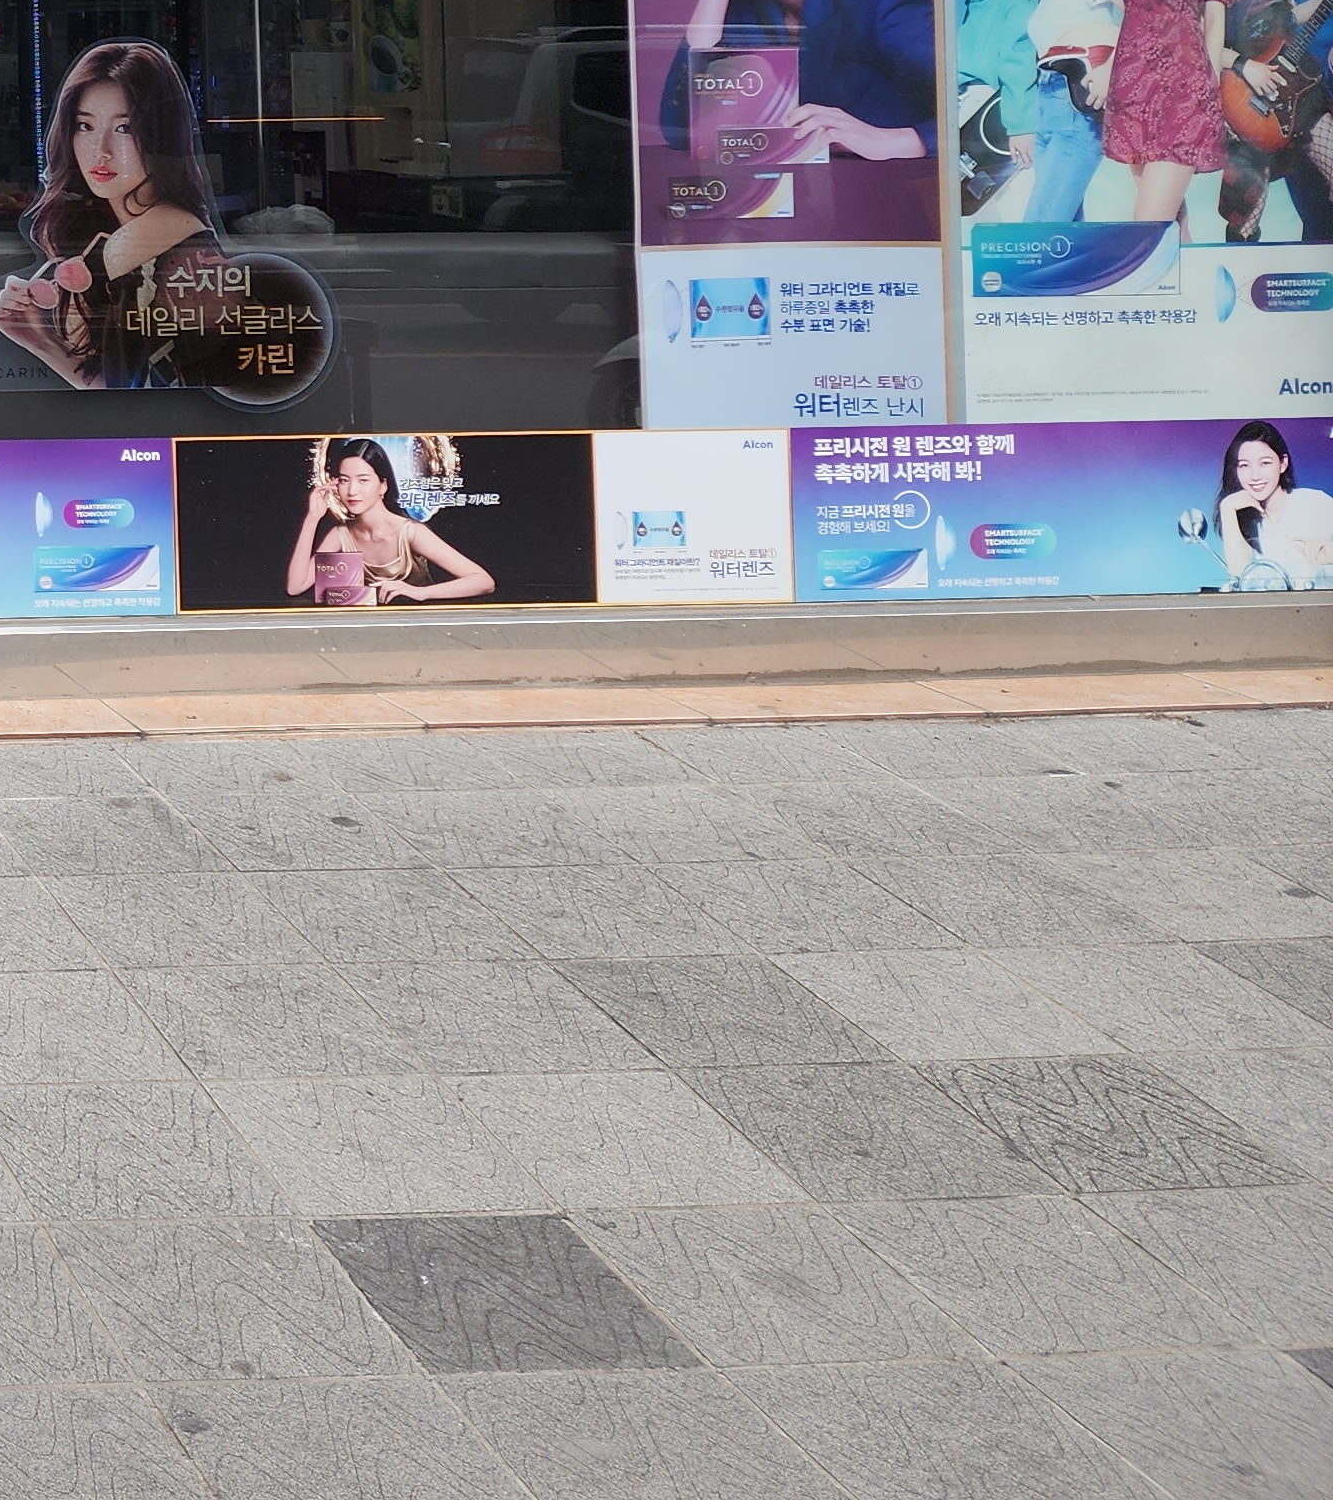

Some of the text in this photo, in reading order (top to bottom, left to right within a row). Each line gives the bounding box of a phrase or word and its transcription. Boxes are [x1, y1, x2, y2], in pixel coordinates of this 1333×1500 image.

[695, 79, 743, 91] TOTAL
[722, 137, 755, 147] TOTAL
[673, 186, 711, 197] TOTAL
[981, 241, 1052, 252] PRECISION
[167, 265, 252, 299] 수지의
[780, 281, 921, 297] 워터 그라디언트 재질로
[1266, 288, 1320, 298] TECHNOLOGY
[780, 300, 875, 315] 하루종일 촉촉한
[125, 304, 324, 338] 데일리 선글라스
[780, 318, 871, 333] 수분 표면 기술!
[974, 309, 1198, 327] 오래 지속되는 선명하고 촉촉한 착용감
[237, 343, 295, 376] 카린
[814, 375, 872, 391] 데일리스
[1279, 378, 1333, 396] Alcon
[793, 393, 925, 418] 워터렌즈 난시
[743, 440, 774, 449] Alcon
[813, 434, 1015, 458] 프리시전 원 렌즈와 함께
[121, 449, 161, 462] Alcon
[814, 460, 982, 484] 촉촉하게 시작해 봐!
[442, 476, 464, 489] 잊고
[397, 490, 501, 508] 워터렌즈를 끼세요
[816, 504, 915, 518] 지금 프리시전 원을
[817, 520, 890, 535] 경험해 보세요!
[709, 549, 746, 559] 데일리스
[709, 561, 775, 579] 워터렌즈
